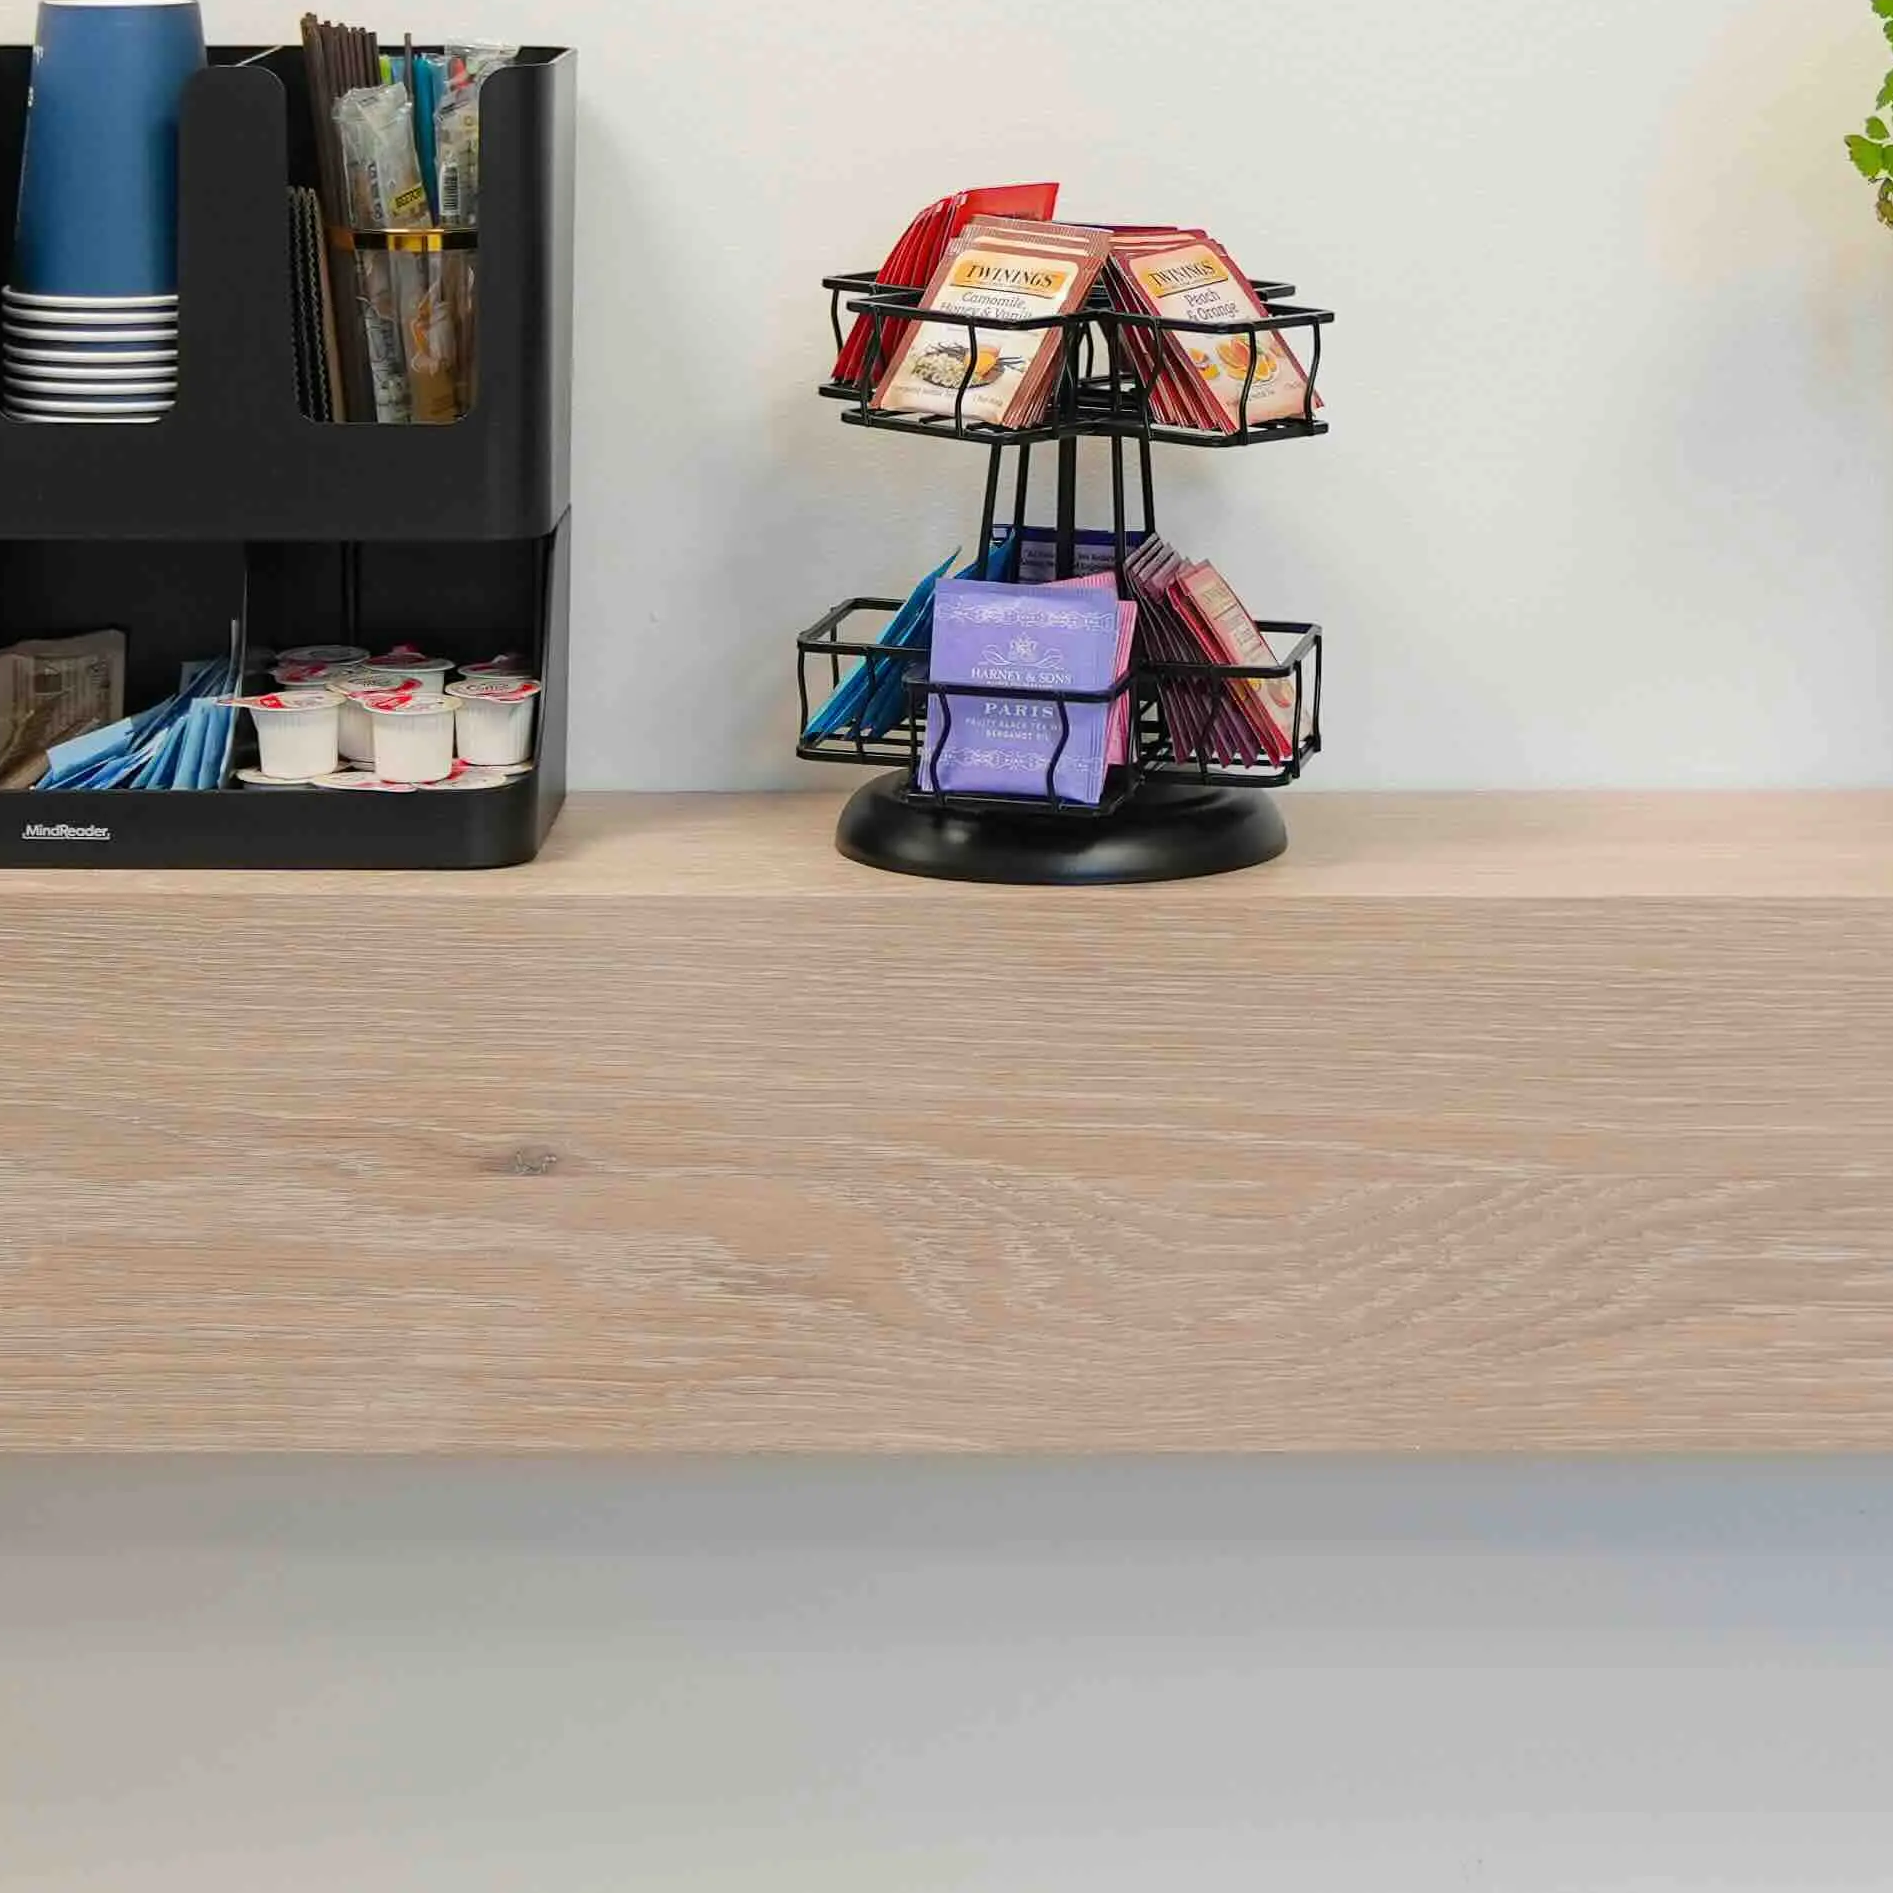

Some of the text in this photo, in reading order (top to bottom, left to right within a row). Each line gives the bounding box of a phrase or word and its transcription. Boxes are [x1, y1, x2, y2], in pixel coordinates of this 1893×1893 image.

[966, 263, 1054, 288] TWININGS
[1148, 261, 1216, 287] TWININGS
[1184, 288, 1221, 307] Peach
[1197, 302, 1239, 320] Orange
[971, 667, 1021, 682] HARNEY
[1025, 673, 1037, 683] &
[1039, 672, 1074, 685] SONS
[984, 702, 1054, 718] PARIS
[25, 823, 109, 838] MindReader
